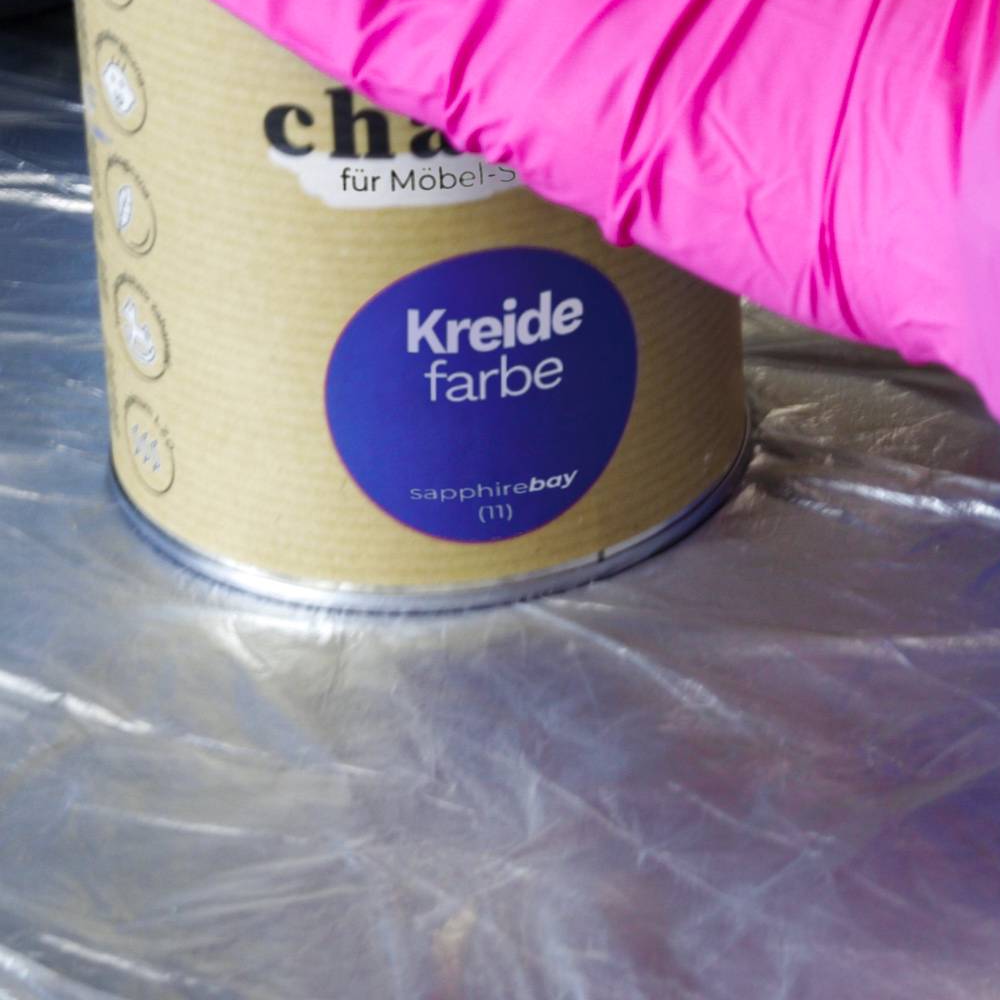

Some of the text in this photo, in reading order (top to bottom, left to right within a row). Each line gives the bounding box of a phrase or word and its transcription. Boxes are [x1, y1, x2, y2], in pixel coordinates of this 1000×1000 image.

[264, 88, 466, 159] cha
[340, 162, 517, 193] für Möbel-S
[405, 290, 585, 354] Kreide
[423, 354, 565, 403] farbe
[410, 469, 578, 502] sapphirebay
[477, 503, 514, 523] (11)
